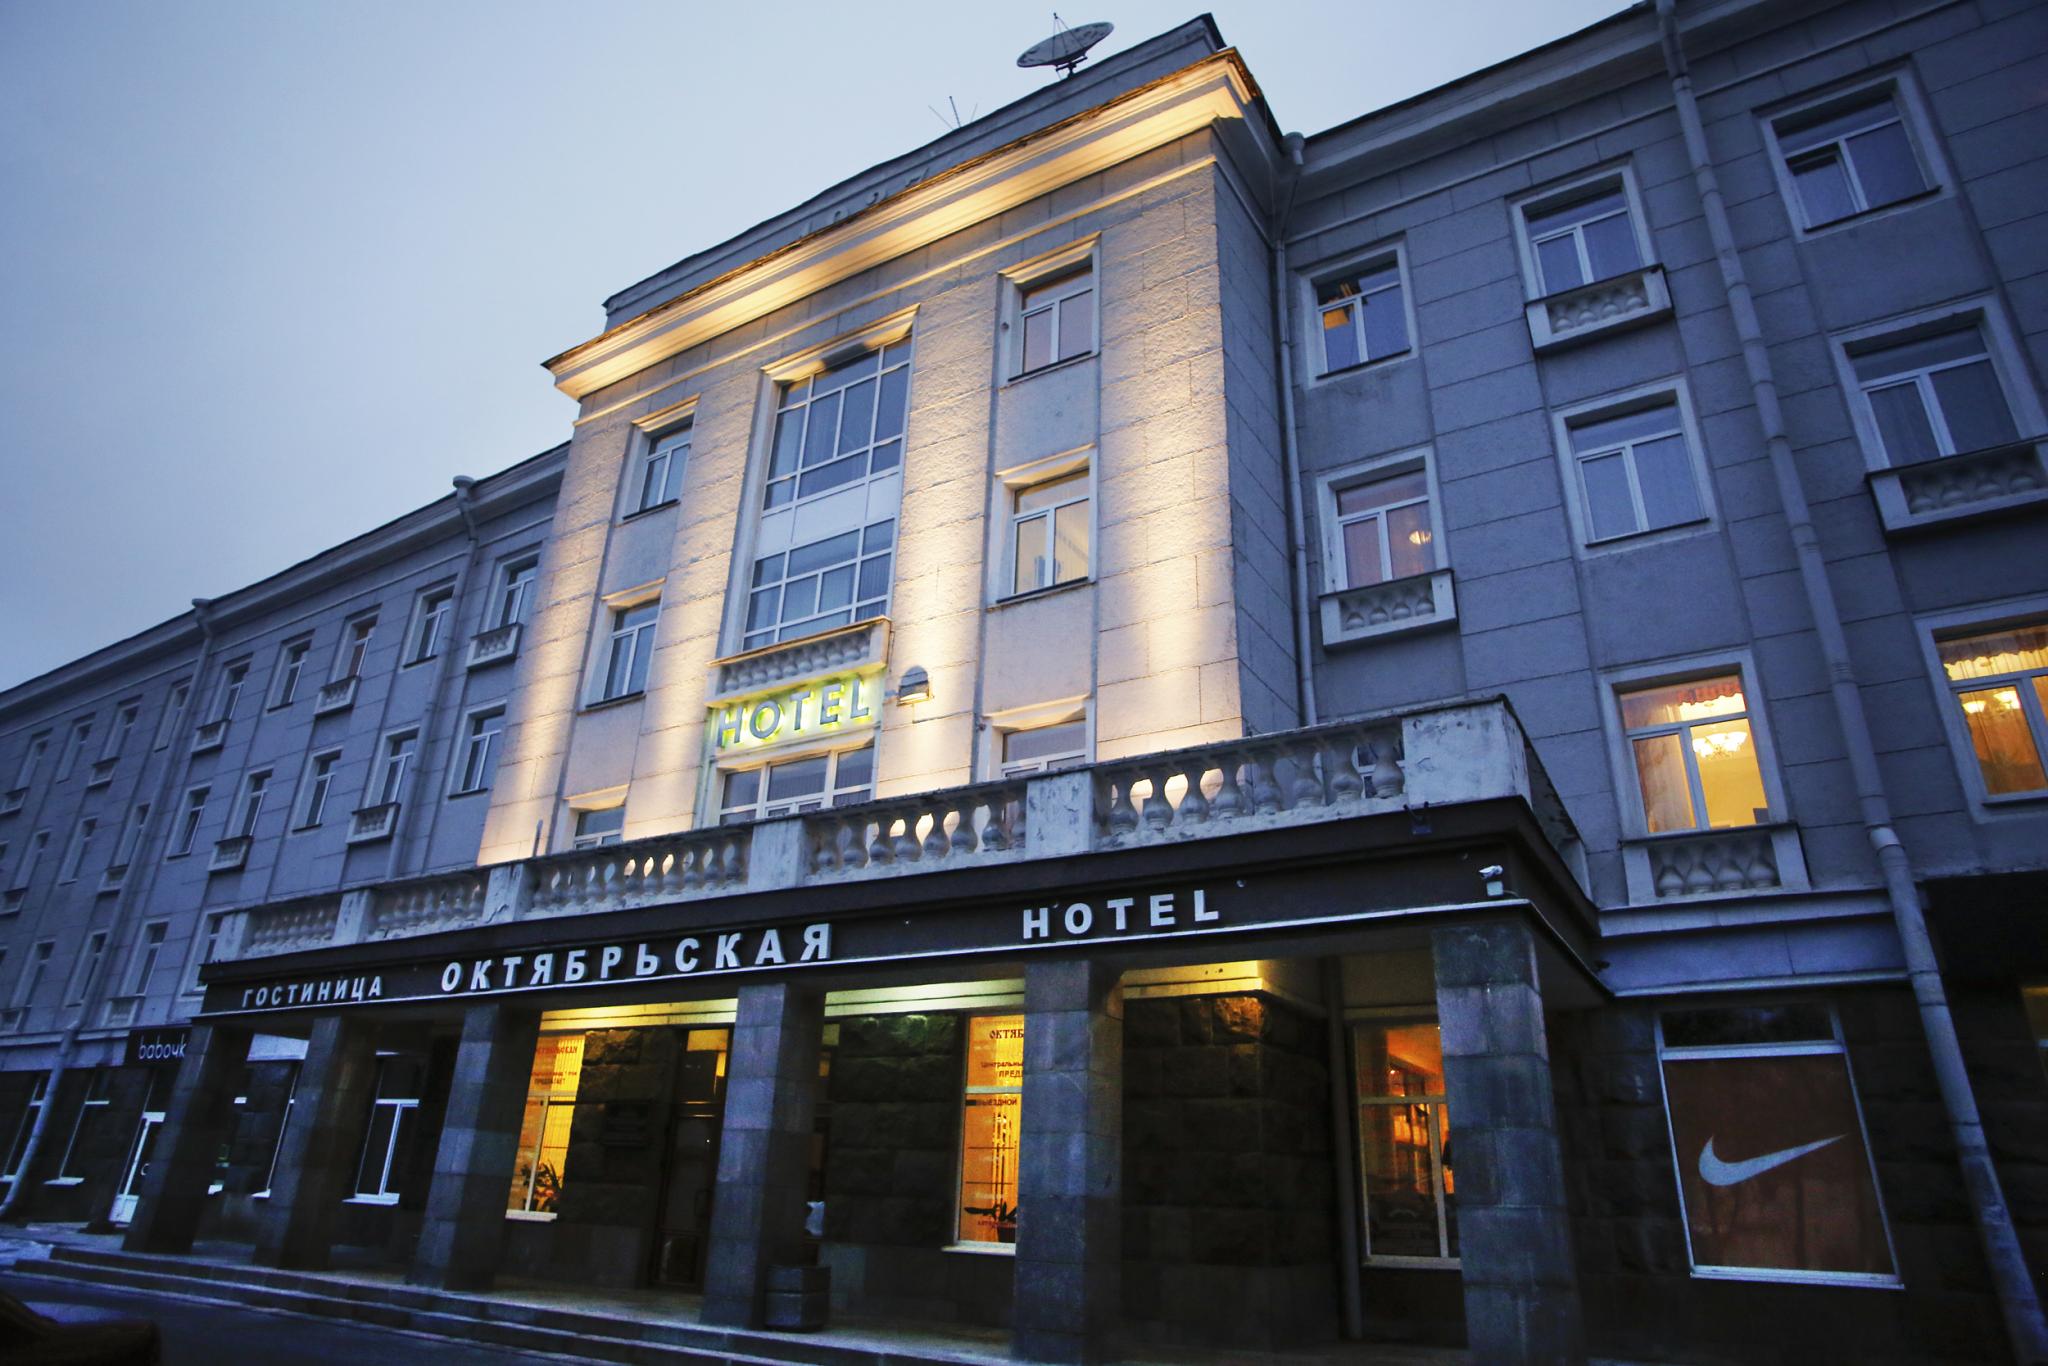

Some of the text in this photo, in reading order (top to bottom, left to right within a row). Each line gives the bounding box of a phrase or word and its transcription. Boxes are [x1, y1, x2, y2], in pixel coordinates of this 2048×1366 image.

[716, 678, 870, 747] HOTEL
[1023, 889, 1219, 939] HOTEL
[242, 923, 831, 1008] ГОСТИНИЦА ОКТЯБРЬСКАЯ
